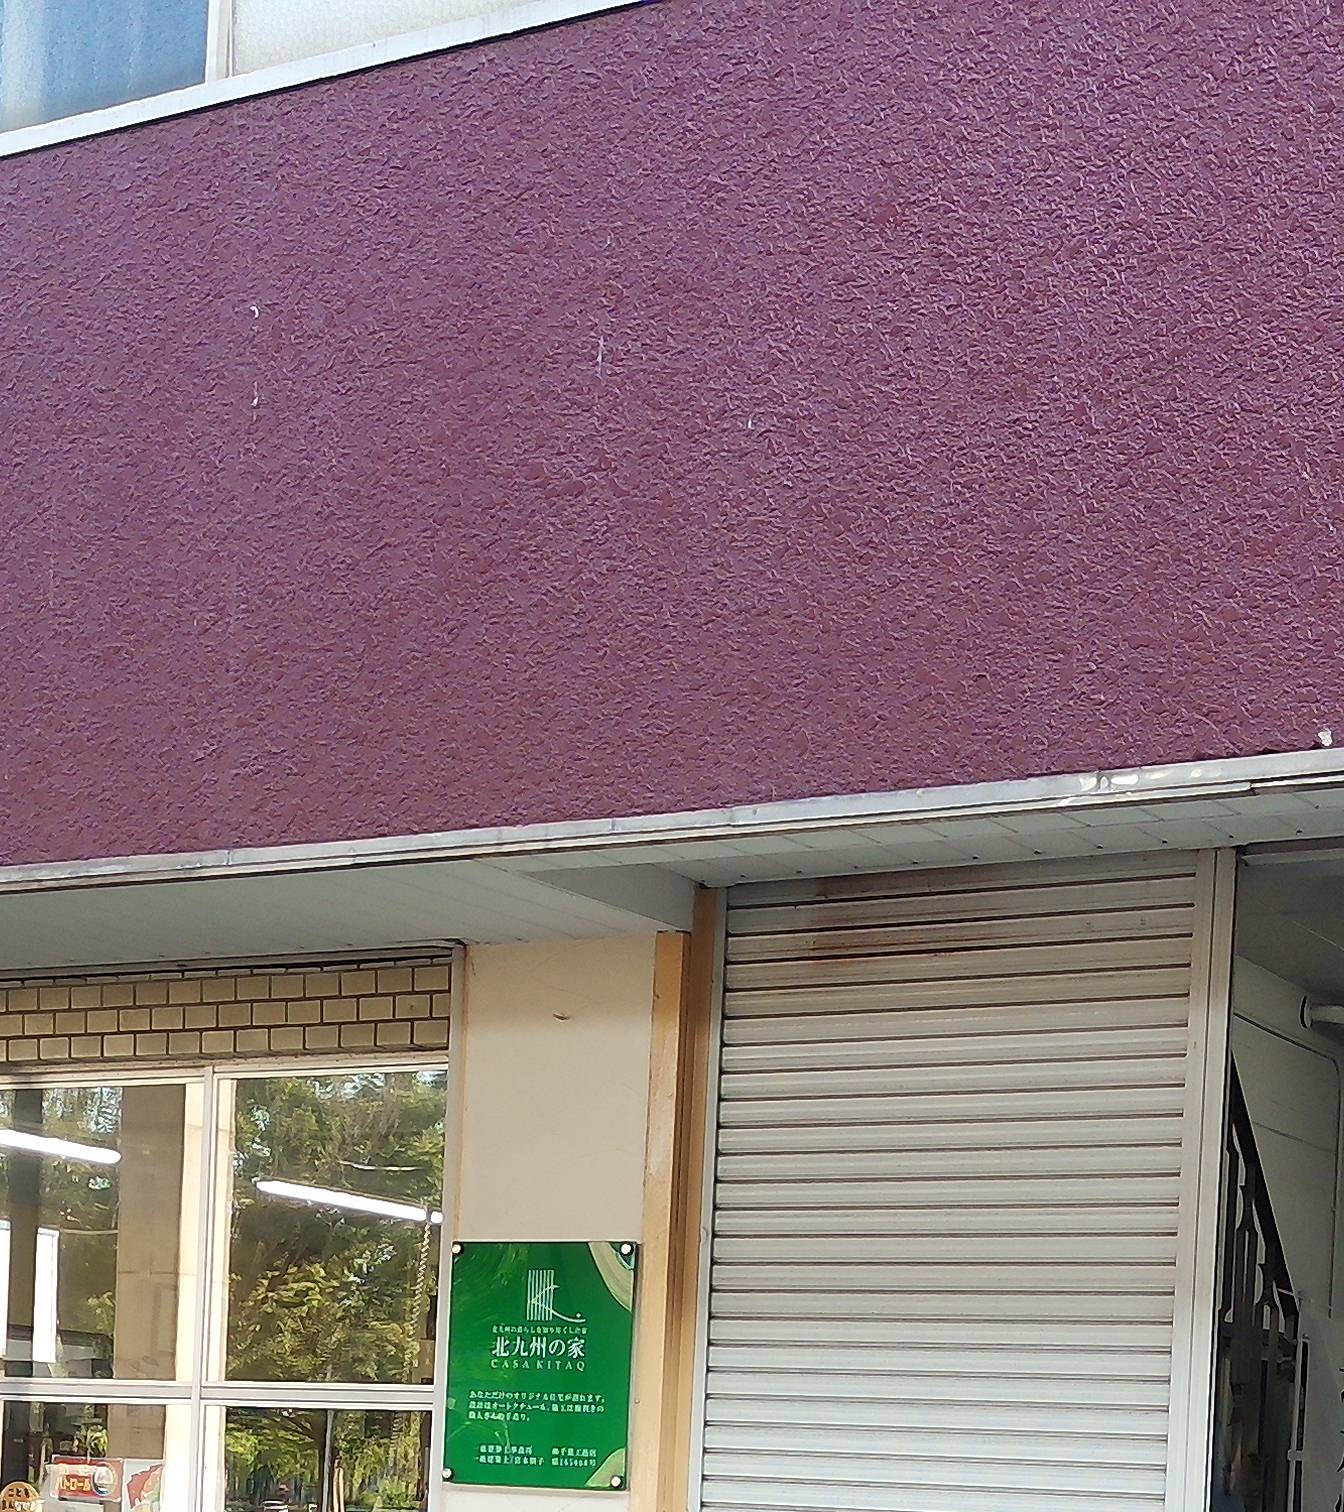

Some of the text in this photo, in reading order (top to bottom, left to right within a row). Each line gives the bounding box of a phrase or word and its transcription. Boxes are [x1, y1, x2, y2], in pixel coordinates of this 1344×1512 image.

[491, 1336, 586, 1359] 北九州の家
[490, 1359, 586, 1372] CASA KITAQ
